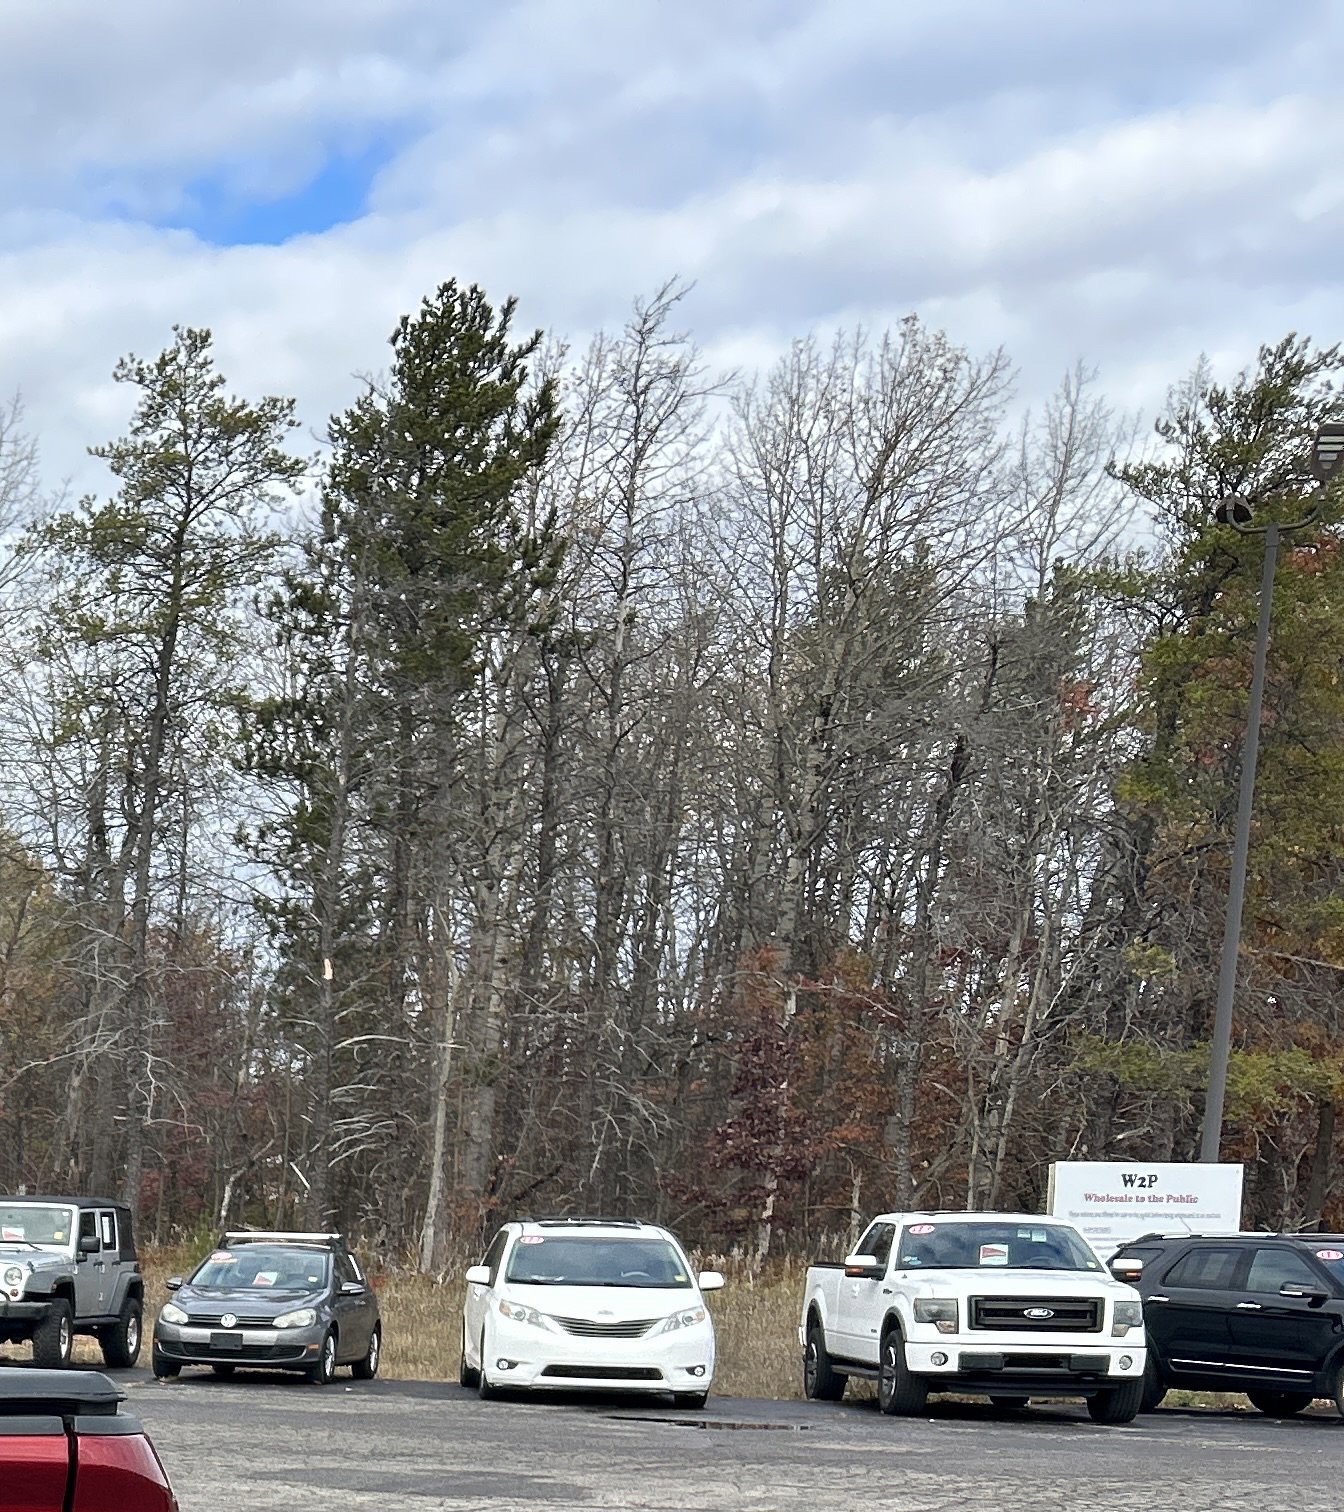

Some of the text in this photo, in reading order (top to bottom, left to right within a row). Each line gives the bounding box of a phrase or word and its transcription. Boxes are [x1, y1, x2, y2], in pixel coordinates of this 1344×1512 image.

[1121, 1173, 1159, 1188] W2P
[1084, 1193, 1199, 1204] Wholesale to the Public
